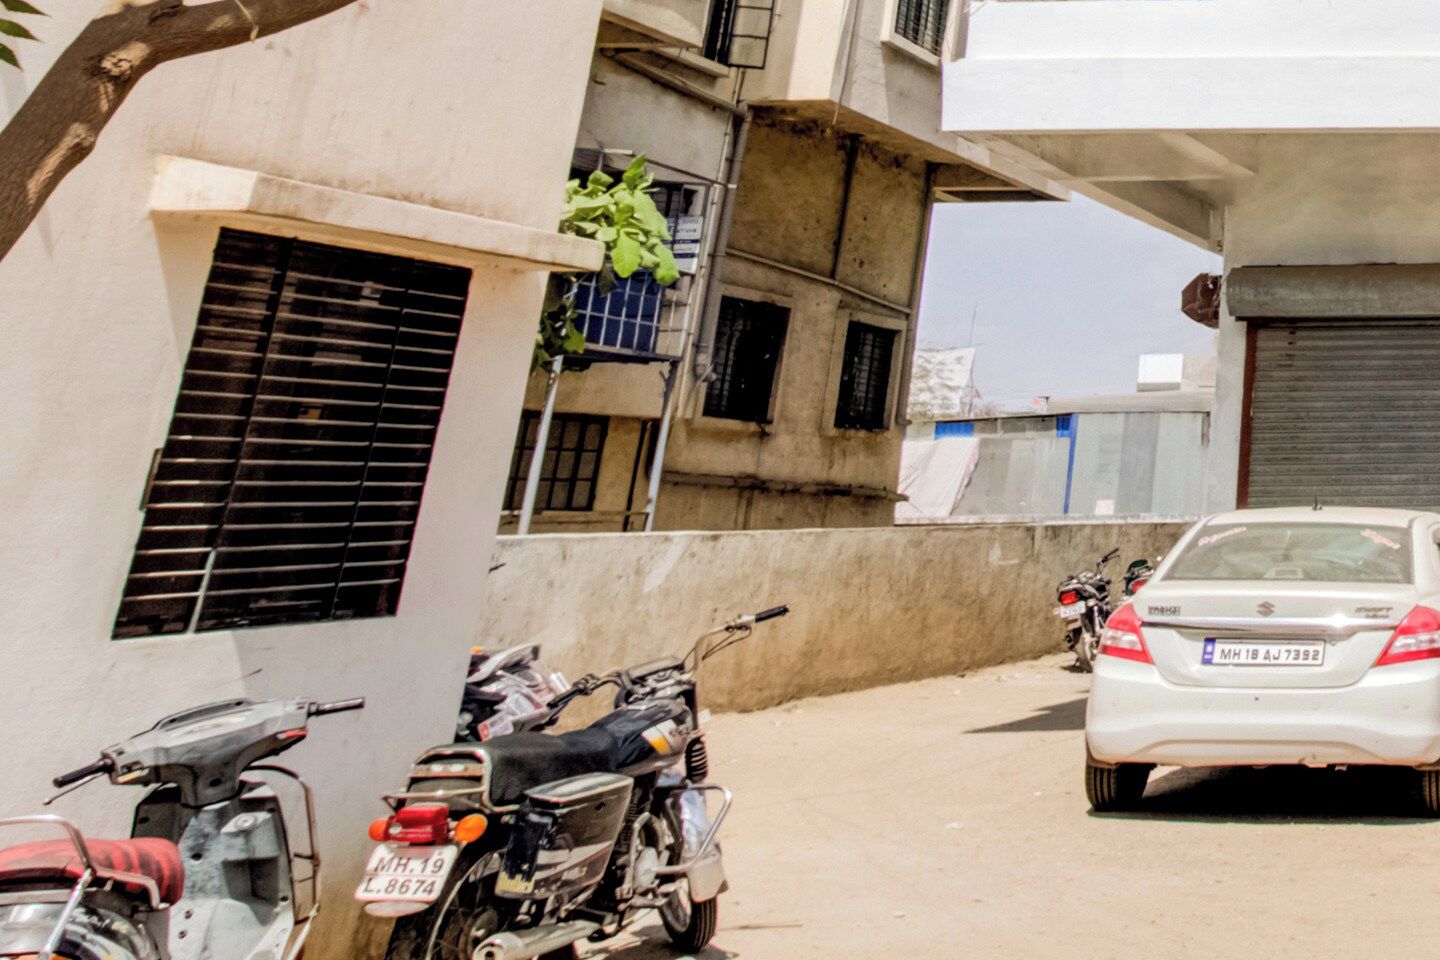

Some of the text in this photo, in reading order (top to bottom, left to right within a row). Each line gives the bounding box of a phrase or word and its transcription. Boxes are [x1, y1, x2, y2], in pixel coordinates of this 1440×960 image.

[1220, 648, 1320, 663] MH 18 AJ 7392
